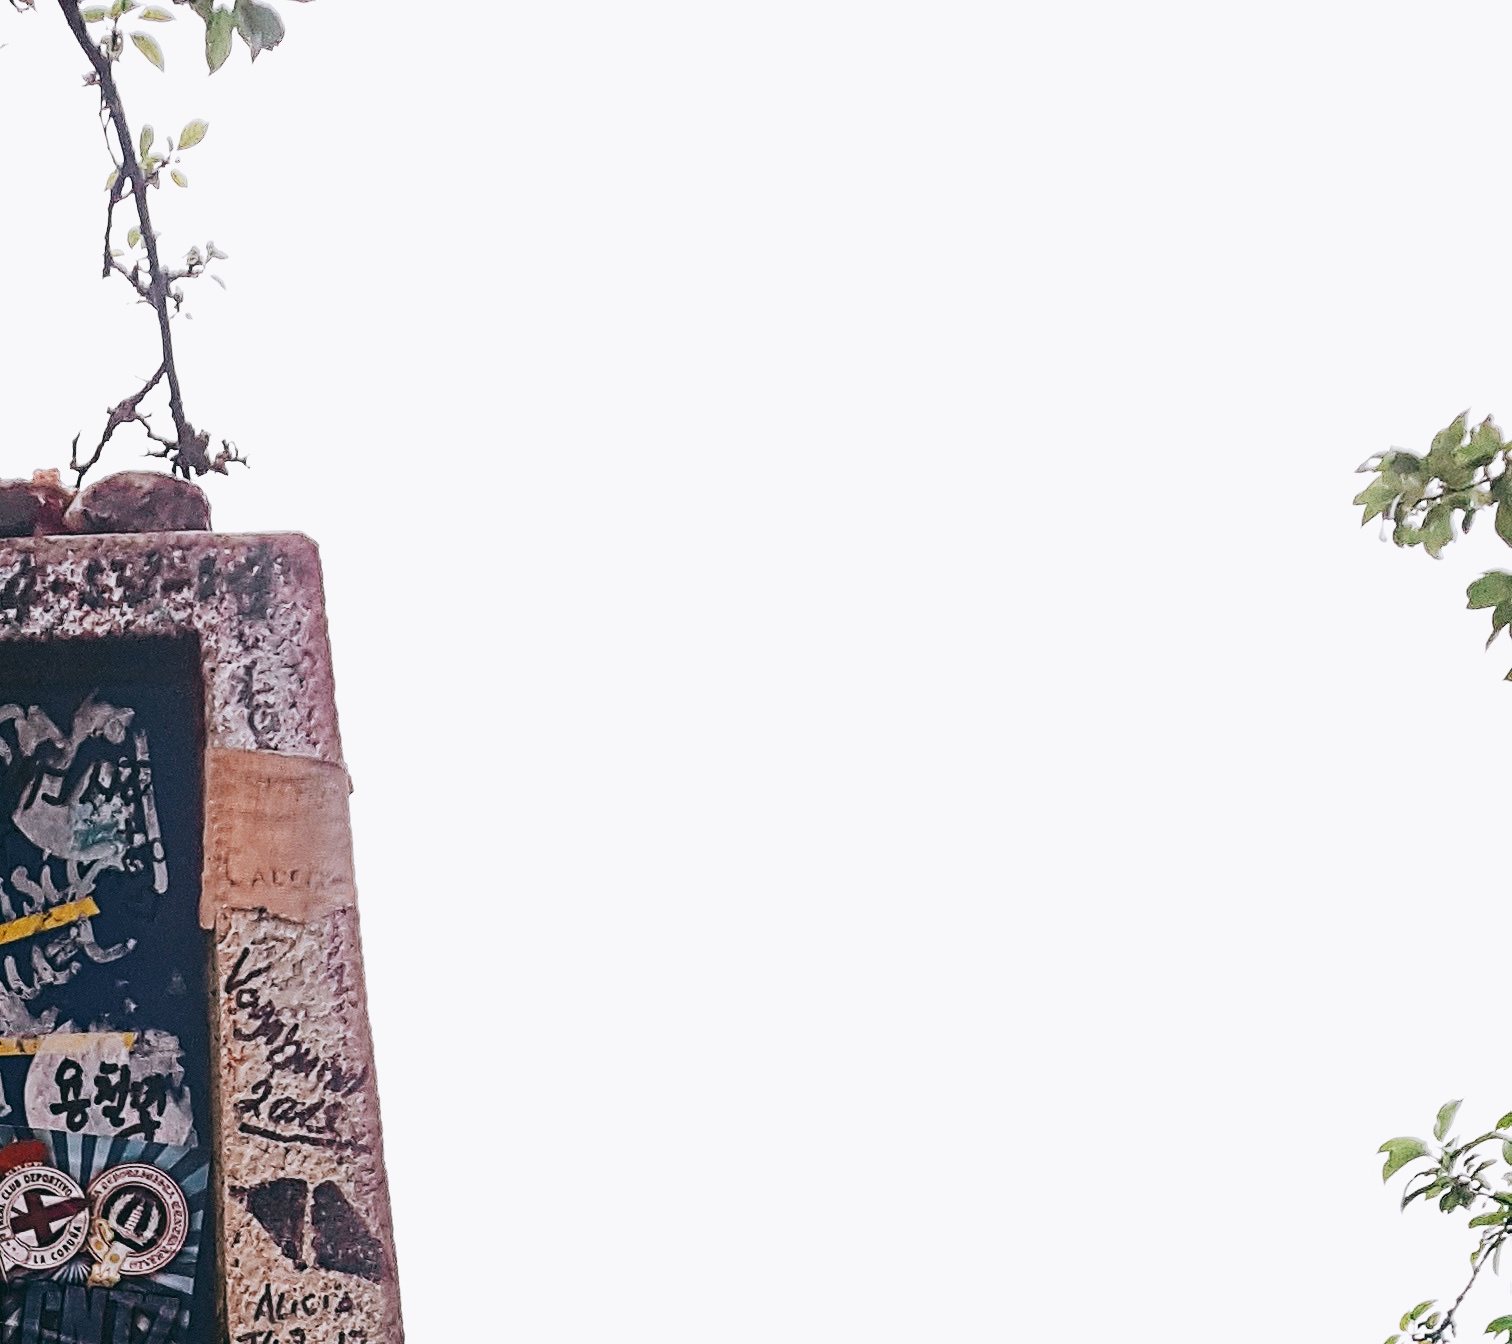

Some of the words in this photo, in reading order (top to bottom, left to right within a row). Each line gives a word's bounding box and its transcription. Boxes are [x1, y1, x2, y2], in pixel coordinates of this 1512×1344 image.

[23, 1172, 74, 1198] DEPORTIVO
[32, 1253, 48, 1266] LA
[50, 1224, 83, 1262] CORUÑA
[253, 1282, 355, 1324] ALICIA
